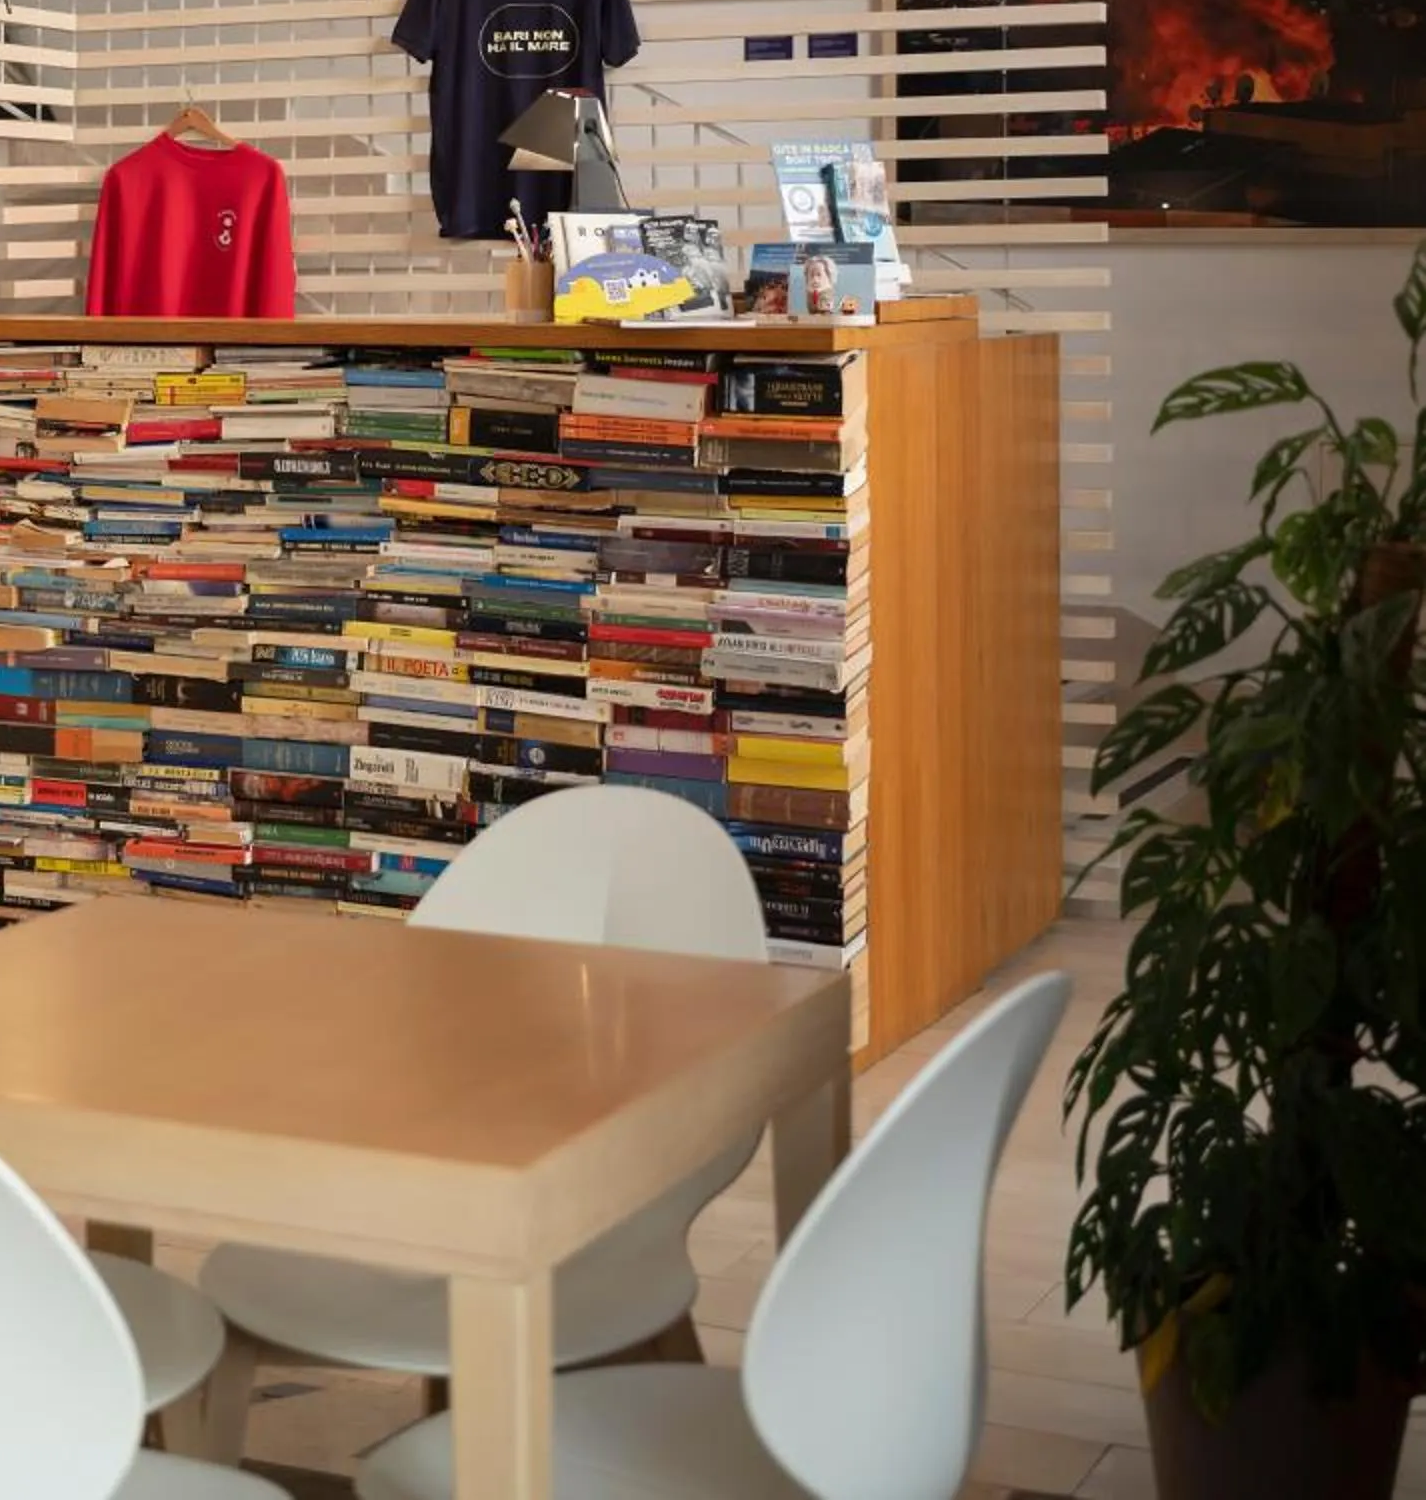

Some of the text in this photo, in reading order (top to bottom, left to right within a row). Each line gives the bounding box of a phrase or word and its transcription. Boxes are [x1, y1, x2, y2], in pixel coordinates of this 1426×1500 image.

[493, 29, 564, 42] BARI NON
[487, 41, 571, 53] HA IL MARE
[404, 658, 449, 677] POETA
